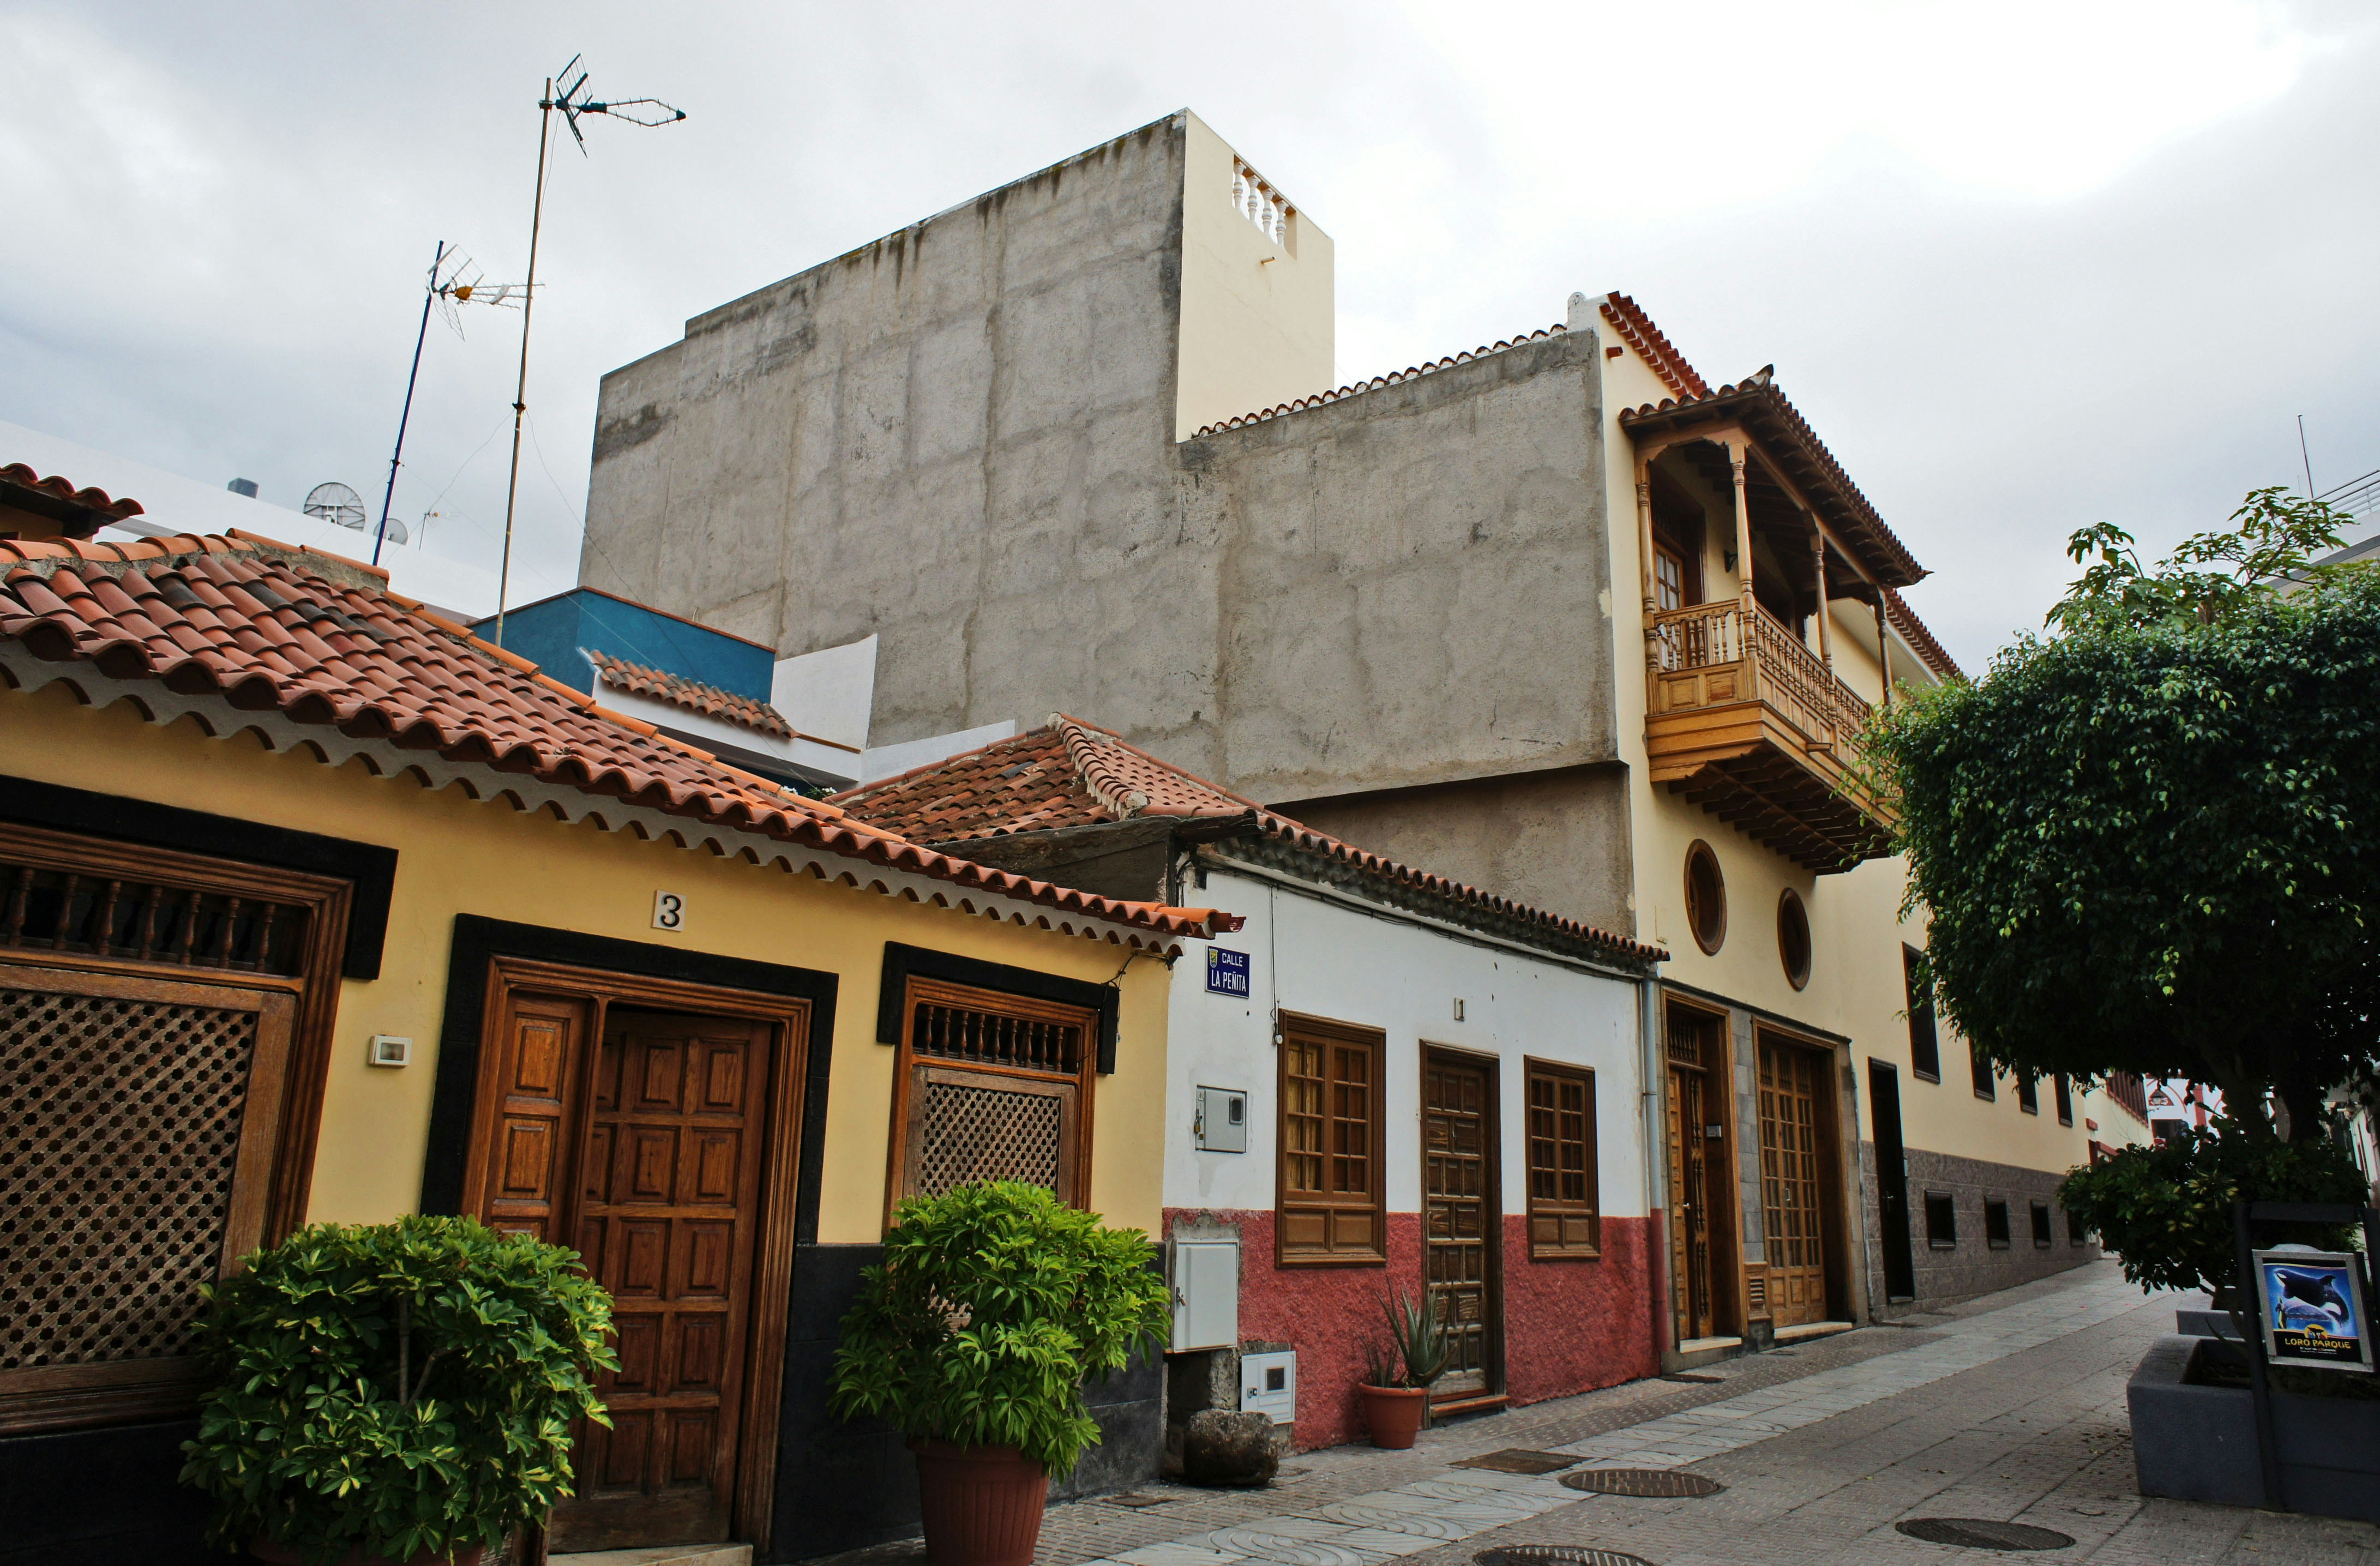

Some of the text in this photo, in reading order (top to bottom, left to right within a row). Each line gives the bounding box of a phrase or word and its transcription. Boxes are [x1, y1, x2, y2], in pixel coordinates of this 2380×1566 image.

[660, 895, 681, 927] 3
[1222, 953, 1243, 967] CALLE
[1211, 969, 1246, 992] LA PEÑITA
[1458, 999, 1464, 1019] 1
[2285, 1338, 2351, 1348] LORO PARQUE
